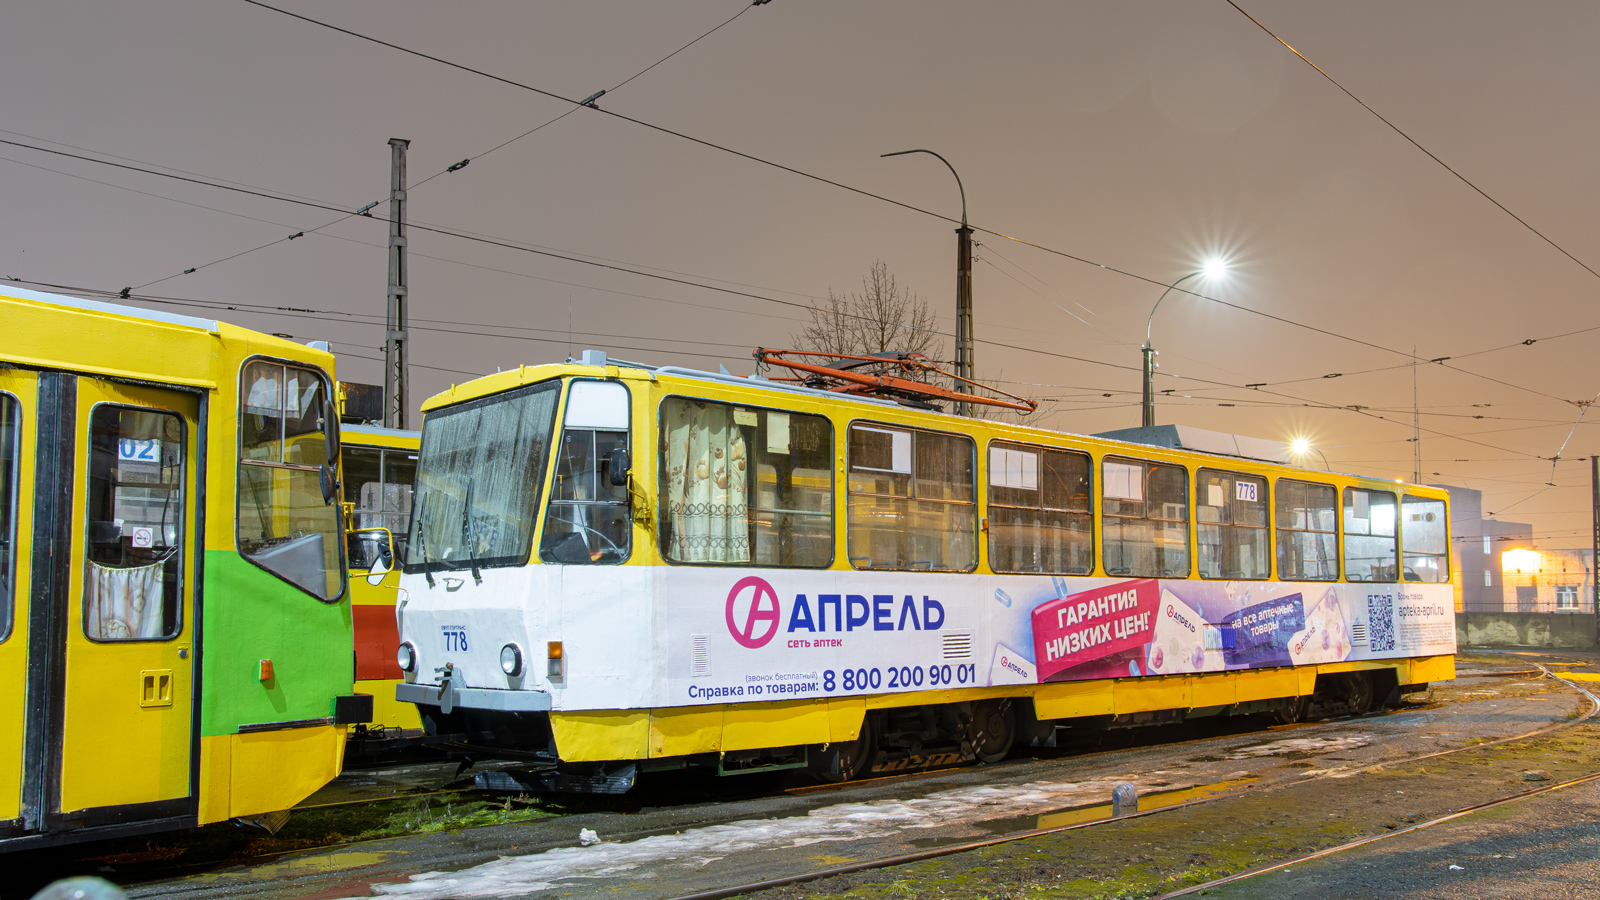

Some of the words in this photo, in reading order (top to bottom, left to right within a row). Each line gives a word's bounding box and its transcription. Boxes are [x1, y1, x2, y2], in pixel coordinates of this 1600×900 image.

[1238, 482, 1256, 500] 778
[787, 593, 945, 633] АПРЕЛЬ
[1057, 588, 1138, 629] ГАРАНТИЯ
[1231, 618, 1242, 629] на
[1243, 613, 1257, 626] все
[1258, 603, 1294, 621] аптечные
[1398, 603, 1444, 619] apteka-april.ru
[1173, 611, 1196, 633] АПРЕЛЬ
[1250, 620, 1280, 637] товары
[443, 631, 468, 652] 778
[787, 639, 811, 648] сеть
[813, 638, 843, 648] аптек
[1045, 622, 1112, 662] НИЗКИХ
[688, 684, 744, 700] Справка
[747, 685, 763, 695] по
[767, 682, 819, 695] товарам:
[823, 669, 836, 693] 8
[842, 667, 882, 692] 800
[887, 665, 924, 689] 200
[929, 664, 951, 686] 90
[957, 663, 976, 685] 01
[745, 674, 773, 684] (звонок
[774, 671, 818, 682] бесплатный)
